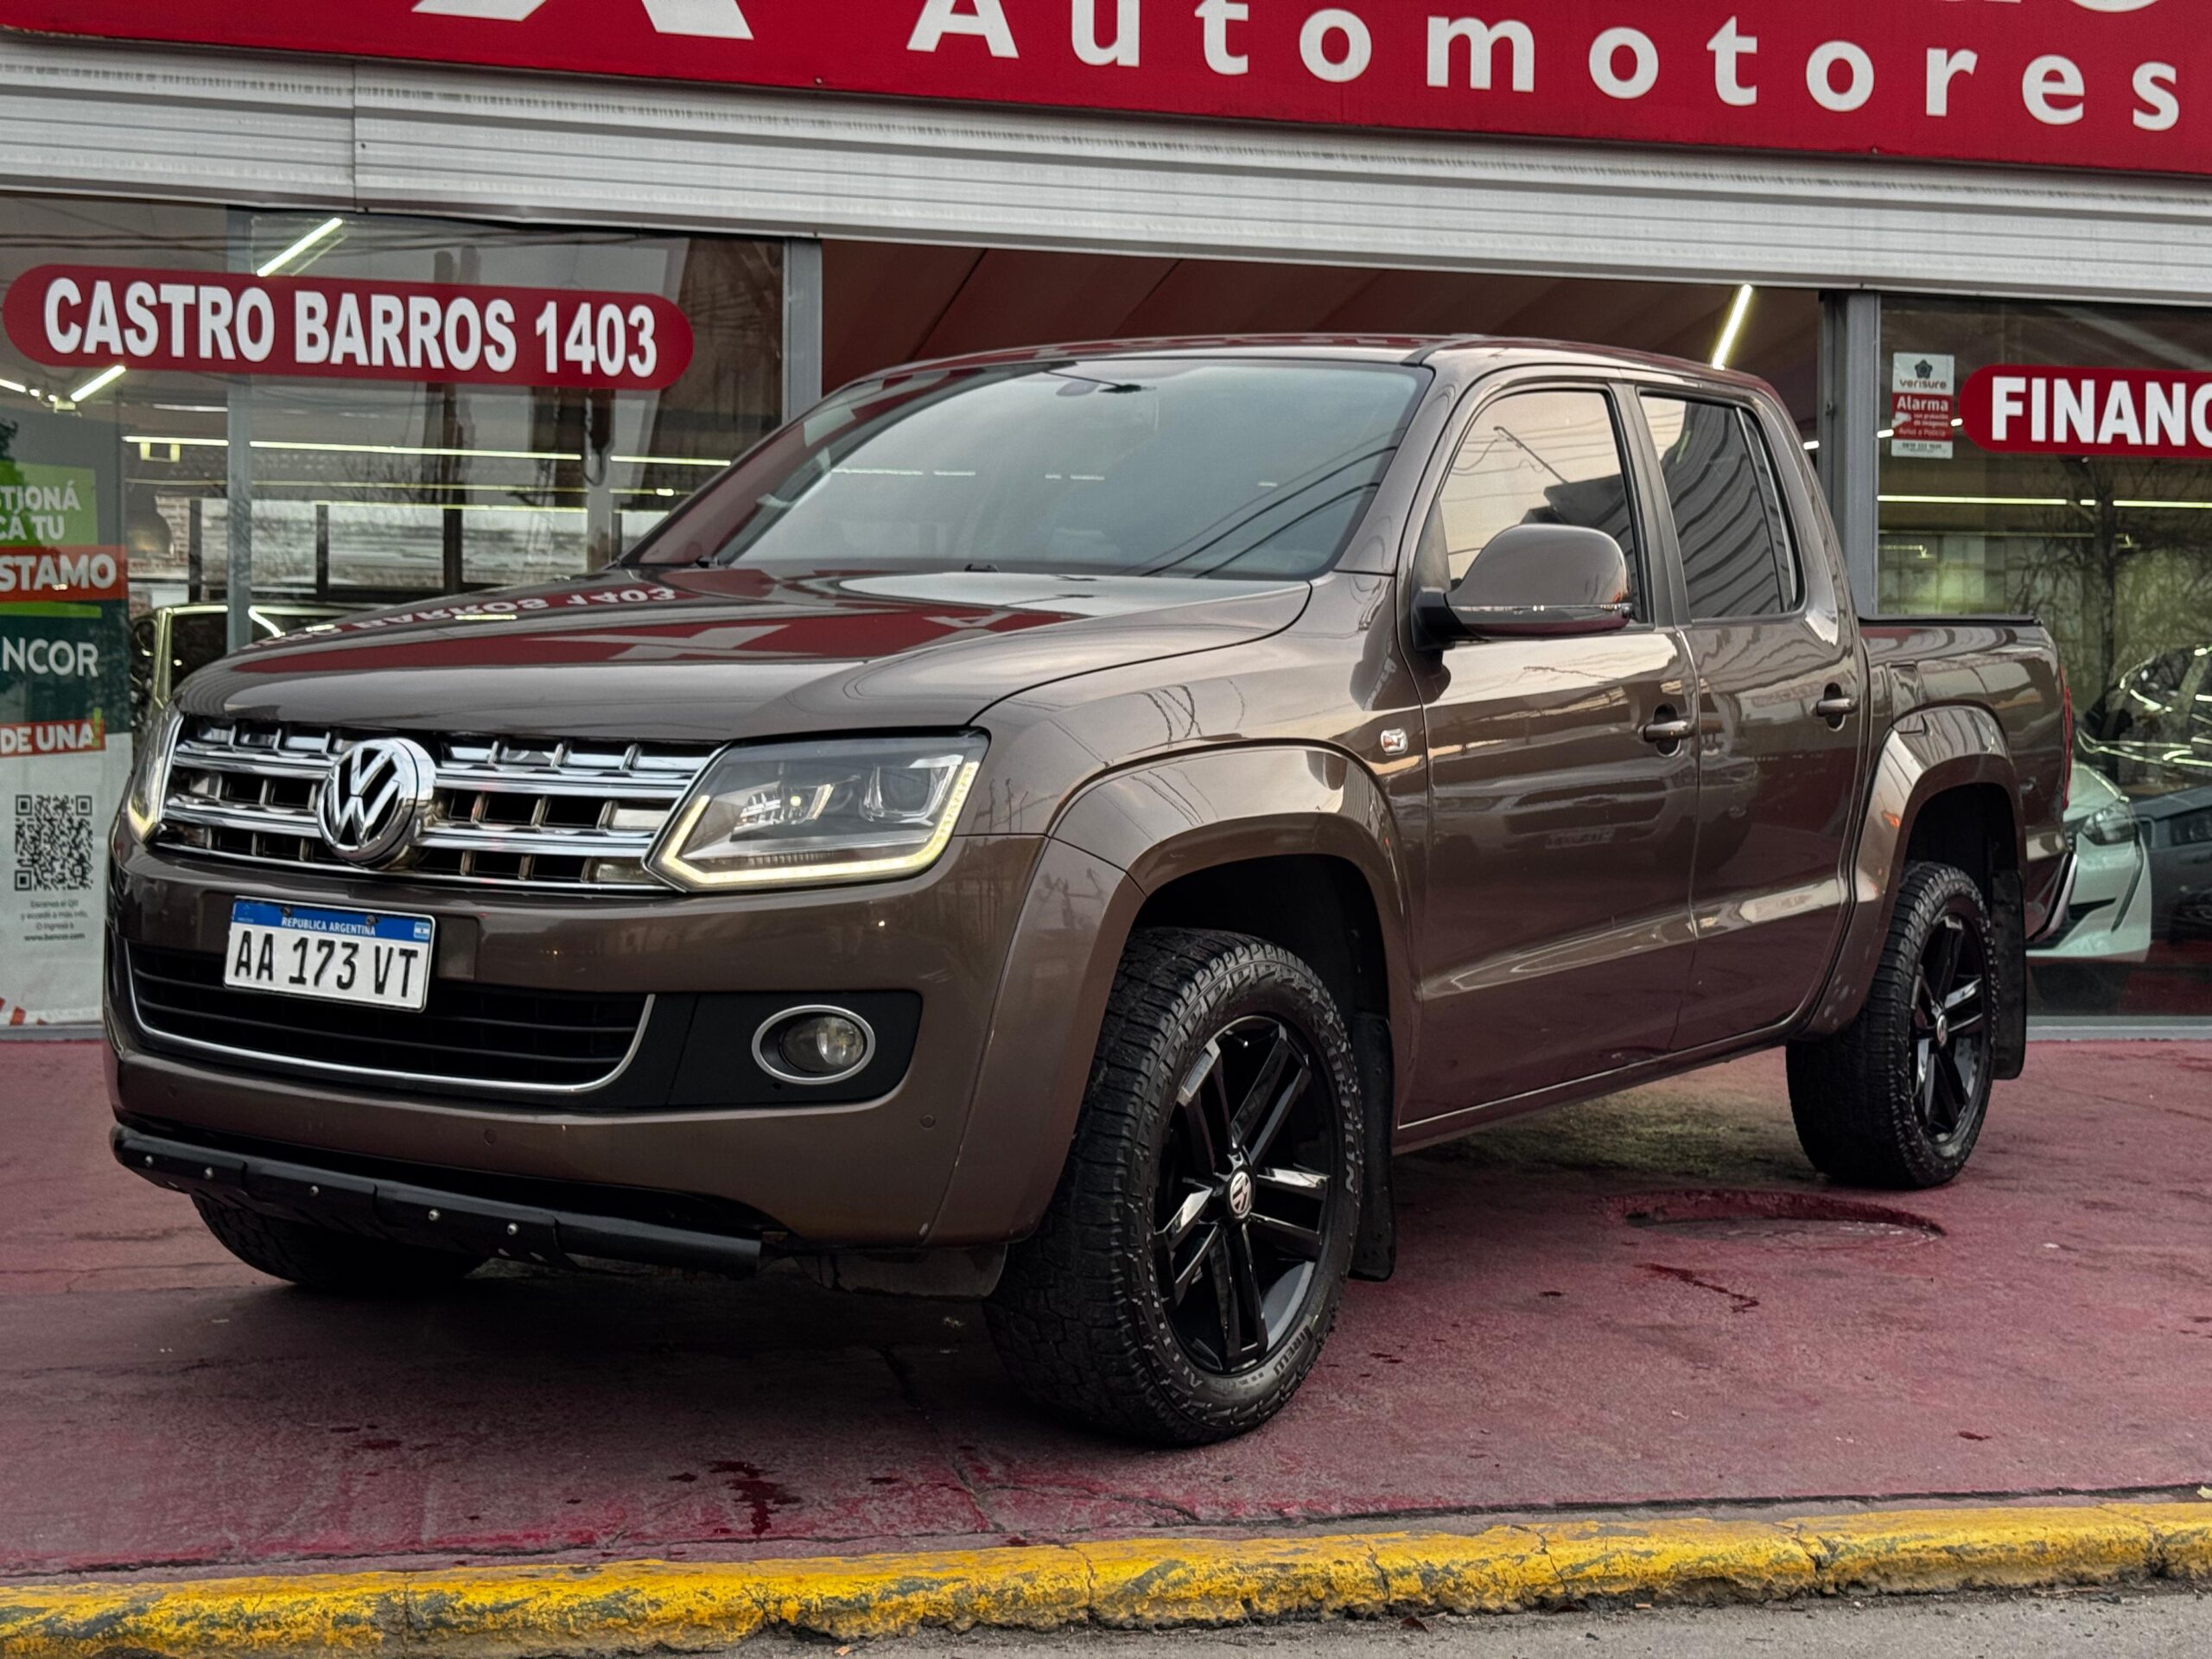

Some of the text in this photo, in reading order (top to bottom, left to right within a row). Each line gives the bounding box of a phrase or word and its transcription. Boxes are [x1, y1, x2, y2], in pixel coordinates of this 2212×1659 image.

[906, 0, 2180, 131] Automotores
[44, 277, 657, 378] CASTRO BARROS 1403
[1899, 378, 1947, 390] verisure
[1897, 395, 1949, 412] Alarma
[31, 515, 65, 540] TU
[0, 636, 99, 677] NCOR
[1, 727, 33, 754] DE
[329, 922, 376, 937] ARGENTINA
[234, 930, 418, 998] AA 173 VT
